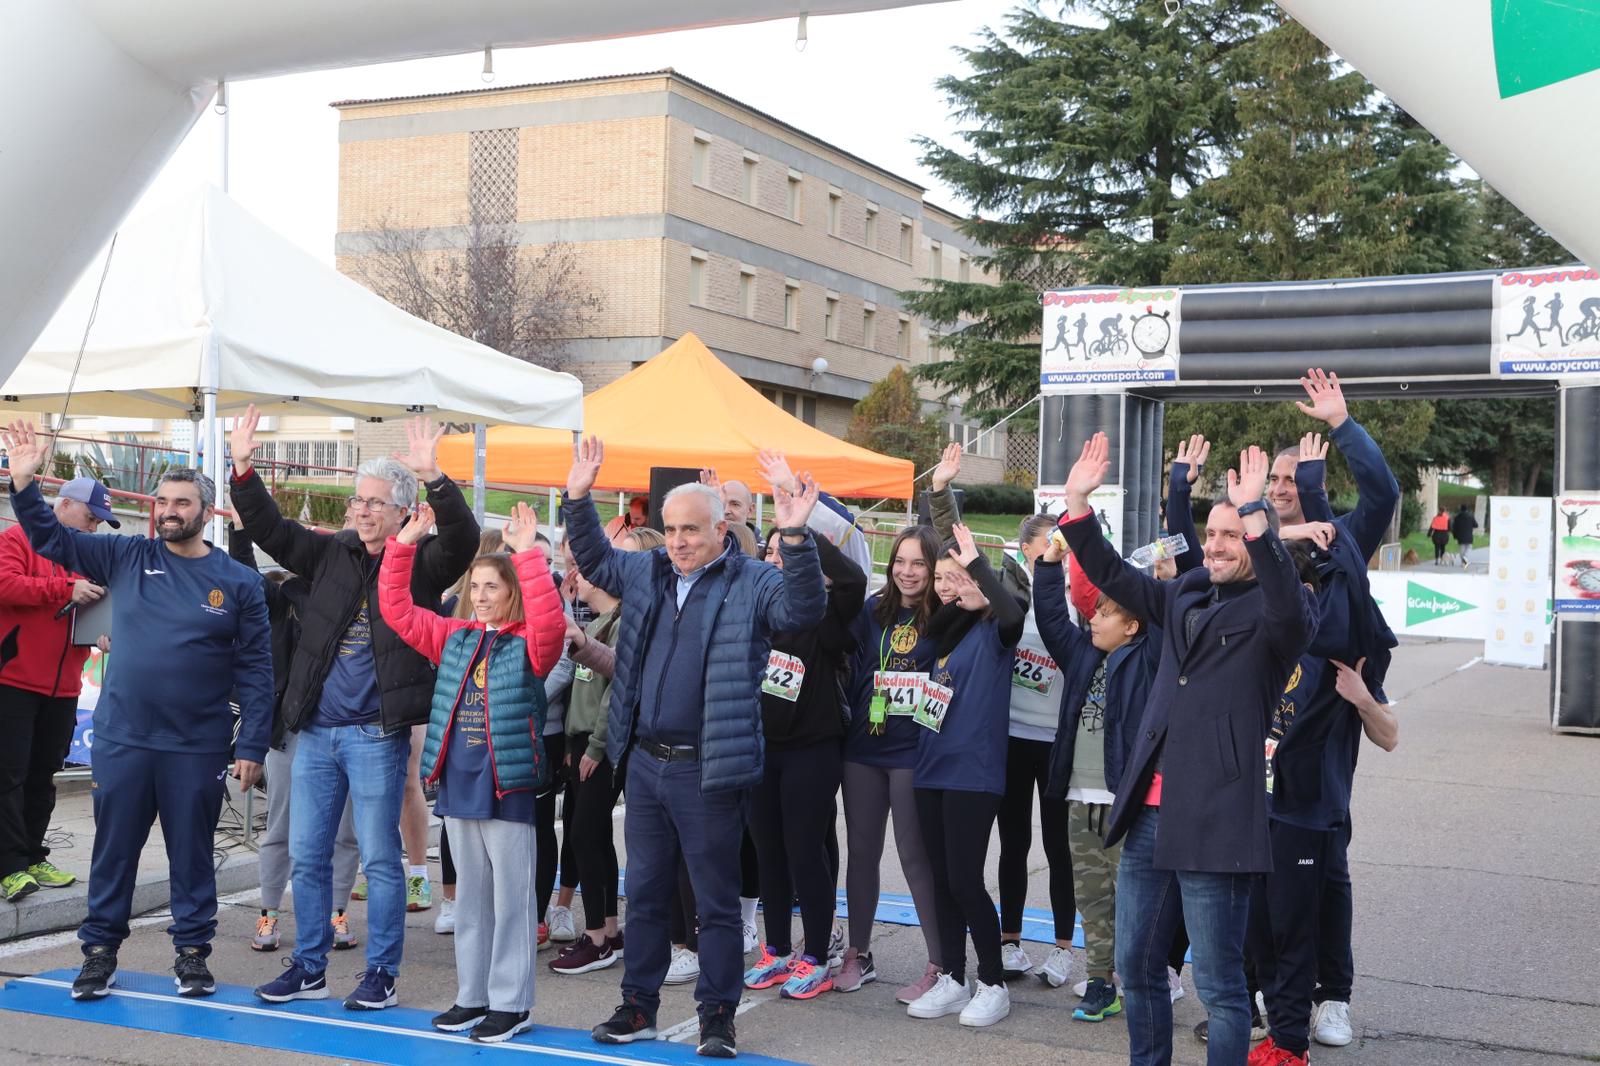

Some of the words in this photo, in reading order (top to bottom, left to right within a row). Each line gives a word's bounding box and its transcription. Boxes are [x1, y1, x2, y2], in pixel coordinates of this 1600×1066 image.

[1047, 370, 1165, 383] www.orycronsport.com
[465, 691, 486, 706] UPS
[923, 698, 944, 720] 440
